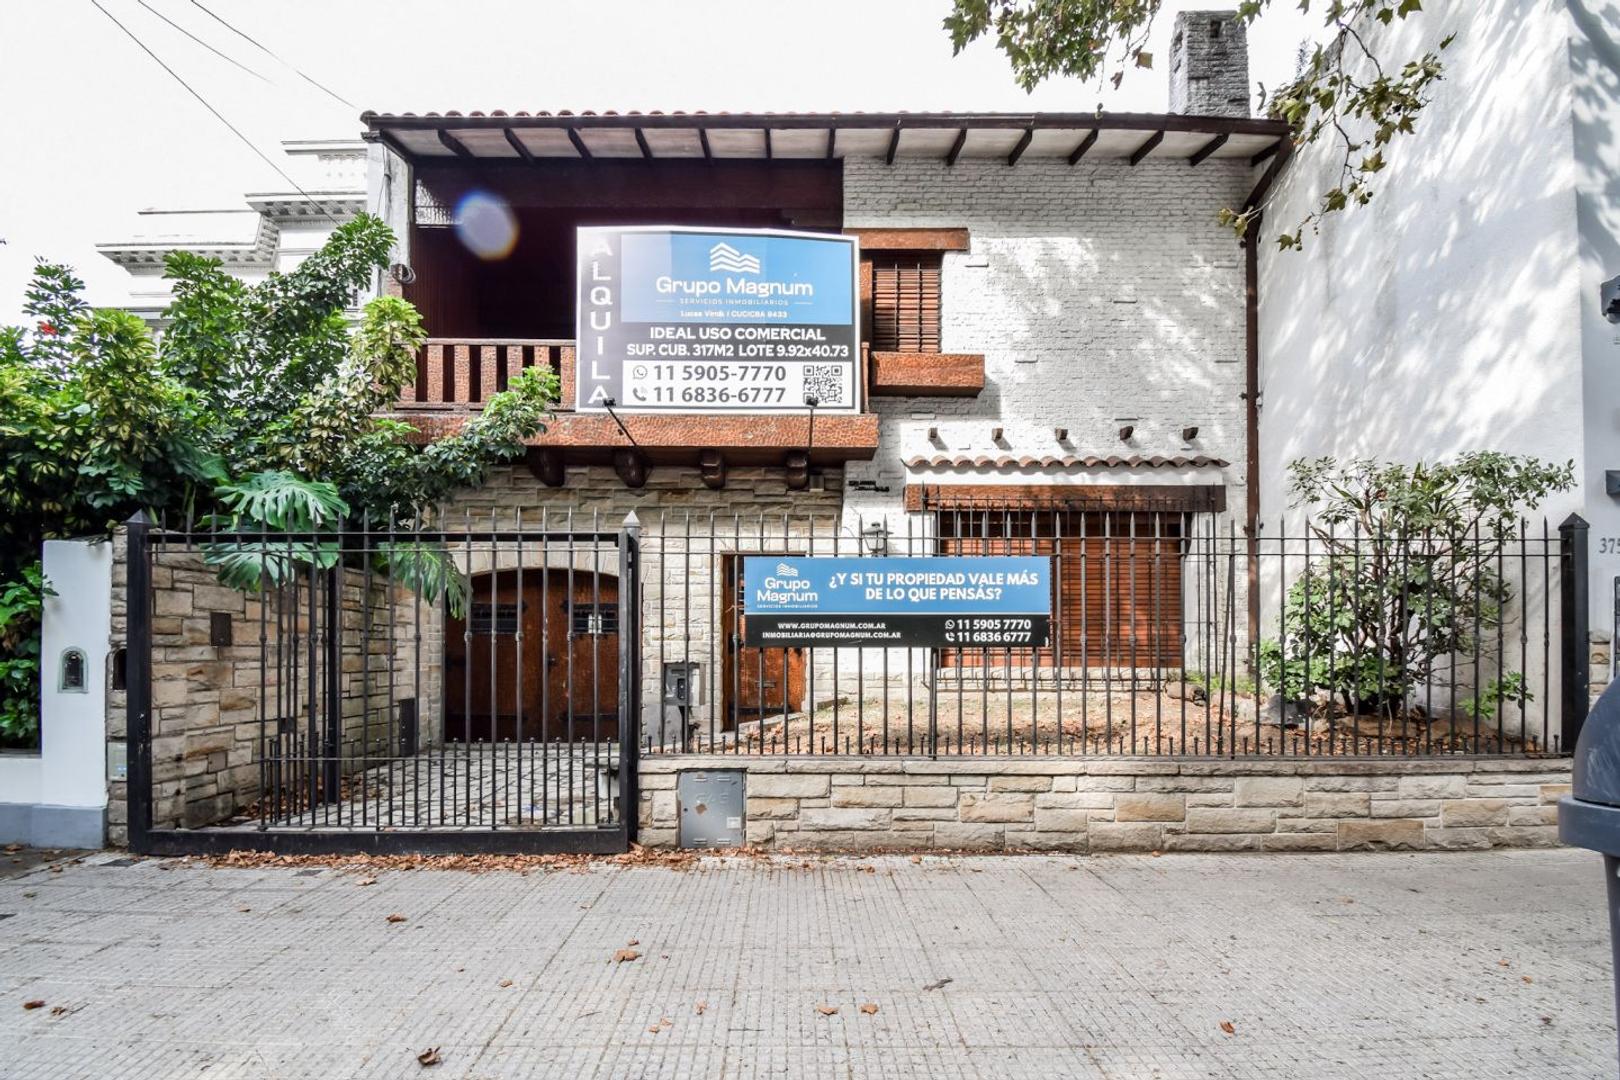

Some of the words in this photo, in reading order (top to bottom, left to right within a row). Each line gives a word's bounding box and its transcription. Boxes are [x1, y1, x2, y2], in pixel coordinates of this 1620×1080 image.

[655, 276, 721, 298] Grupo
[726, 277, 814, 298] Magnum
[650, 327, 697, 340] IDEAL
[699, 327, 732, 340] USO
[734, 328, 827, 341] COMERCIAL
[626, 344, 656, 356] SUP.
[658, 344, 691, 357] CUB.
[692, 344, 735, 357] 317M2
[739, 345, 774, 357] LOTE
[776, 345, 849, 358] 9.92x40.73
[654, 366, 675, 380] 11
[682, 365, 787, 381] 5905-7770
[654, 388, 675, 402] 11
[682, 387, 787, 403] 6836-6777
[764, 577, 811, 592] Grupo
[829, 573, 847, 589] ¿Y
[850, 573, 863, 585] SI
[866, 573, 883, 586] TU
[887, 573, 965, 586] PROPIEDAD
[968, 573, 1004, 585] VALE
[1007, 570, 1039, 586] MÁS
[757, 589, 818, 604] Magnum
[866, 588, 883, 600] DE
[886, 588, 905, 600] LO
[907, 588, 937, 602] QUE
[940, 585, 1003, 600] PENSÁS?
[957, 620, 970, 629] 11
[973, 620, 1001, 630] 5905
[1003, 620, 1032, 630] 7770
[957, 632, 970, 642] 11
[973, 632, 1002, 642] 6836
[1003, 632, 1031, 642] 6777
